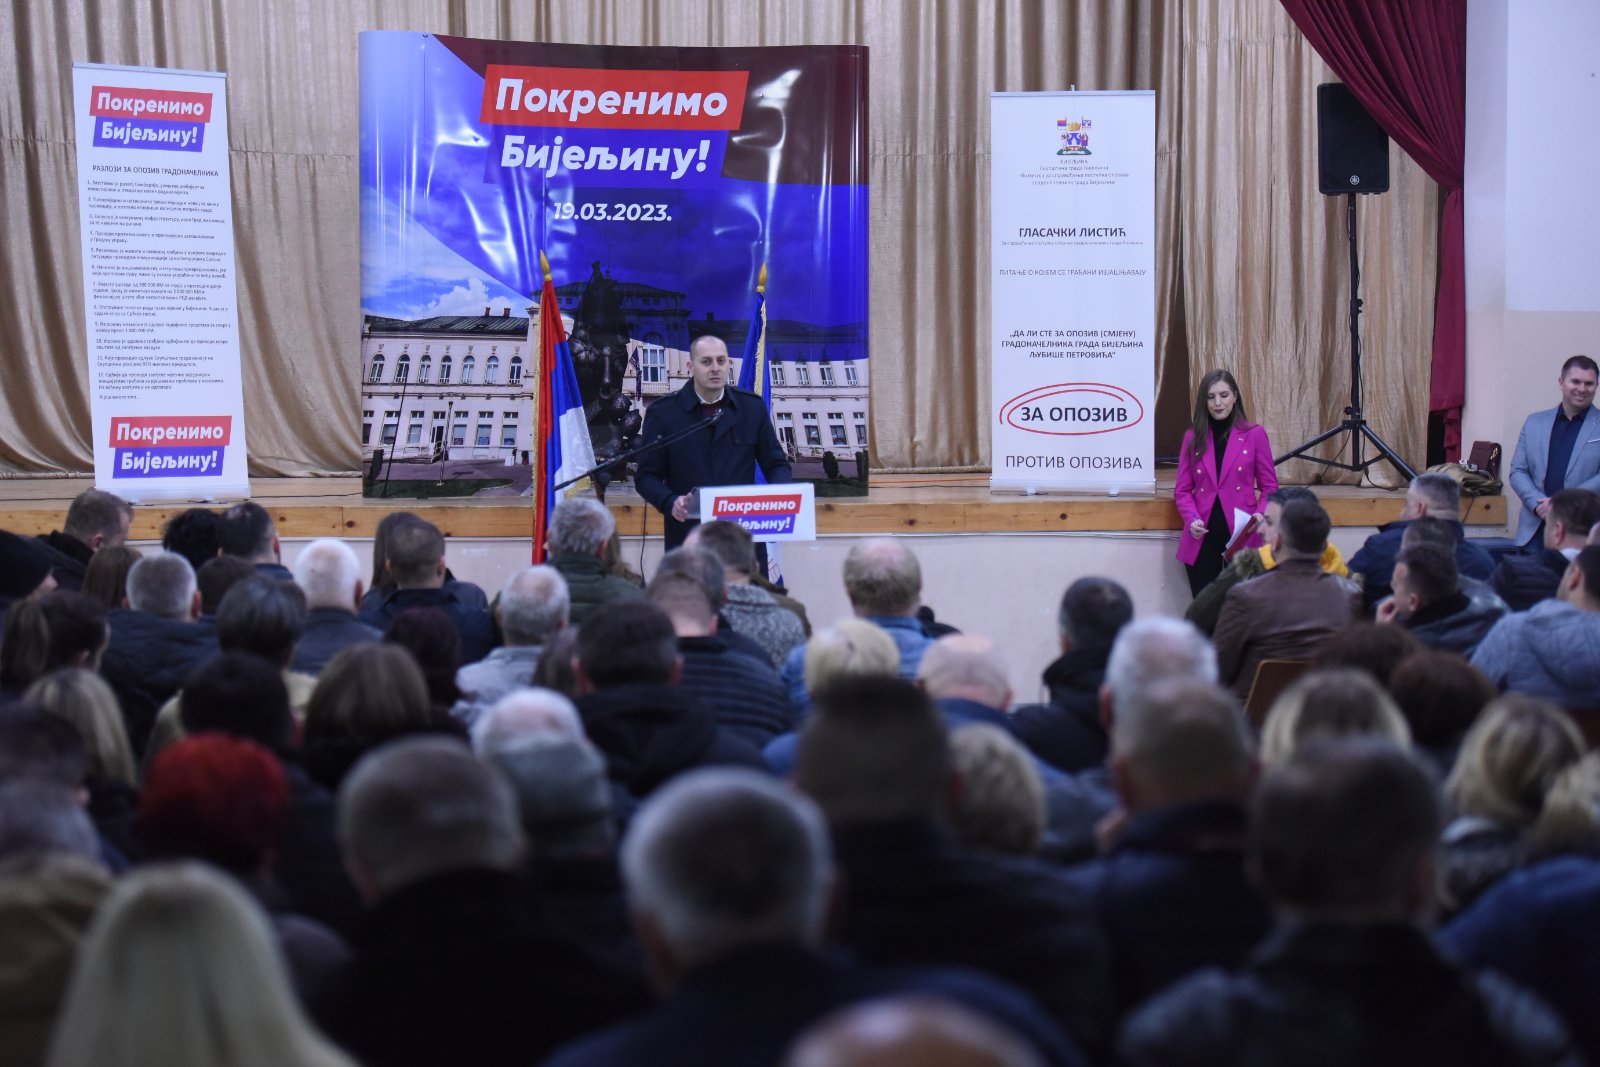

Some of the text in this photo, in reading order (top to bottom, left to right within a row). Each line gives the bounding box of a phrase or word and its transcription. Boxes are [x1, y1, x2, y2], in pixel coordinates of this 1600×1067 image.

[98, 92, 204, 116] Покренимо
[496, 78, 728, 122] Покренимо
[102, 122, 198, 148] Бијељину!
[500, 135, 710, 180] Бијељину!
[133, 166, 160, 174] ОПОЗИВ
[162, 168, 218, 176] ГРАДОНАЧЕЛНИКА
[554, 202, 672, 221] 19.03.2023.
[1019, 228, 1126, 238] ГЛАСАЧКИ ЛИСТИЋ
[1100, 330, 1136, 338] (СМЈЕНУ)
[1021, 406, 1128, 422] ЗА ОПОЗИВ
[116, 423, 224, 444] Покренимо
[121, 450, 218, 474] Бијељину!
[1006, 456, 1142, 470] ПРОТИВ ОПОЗИВА
[718, 500, 796, 514] Покренимо
[738, 517, 791, 532] јељину!
